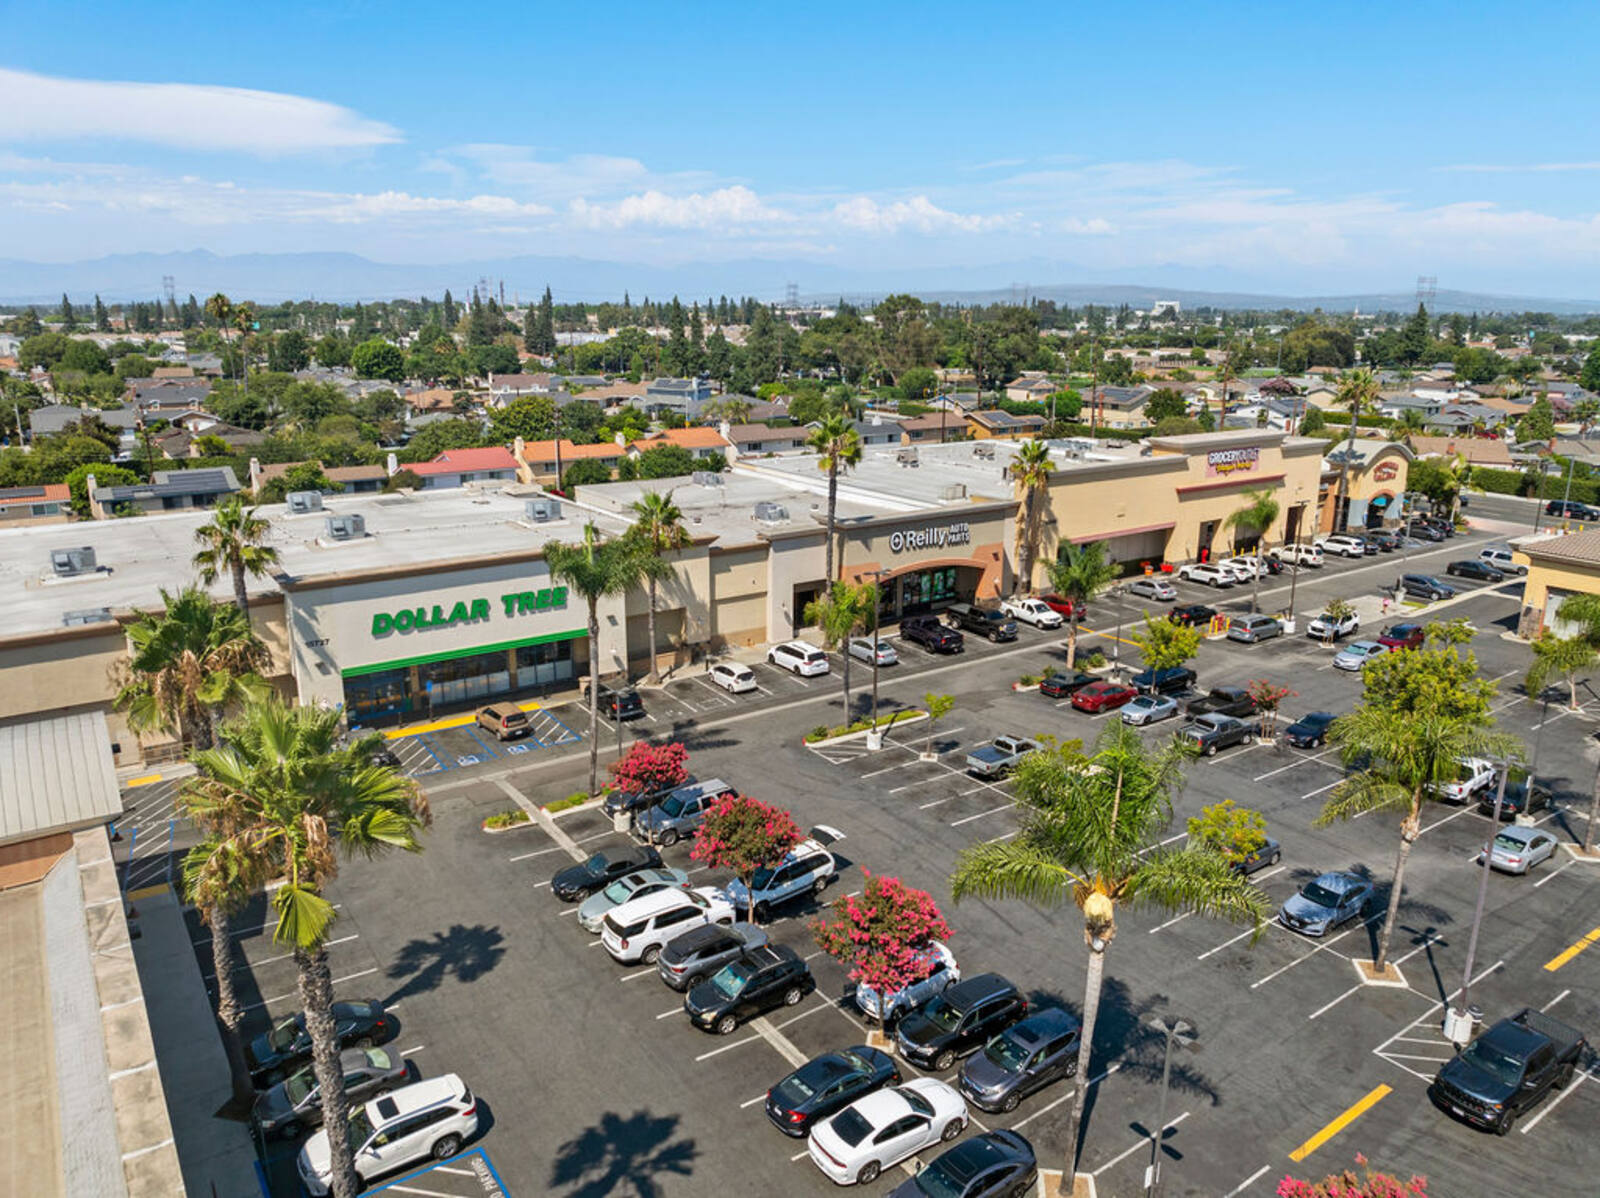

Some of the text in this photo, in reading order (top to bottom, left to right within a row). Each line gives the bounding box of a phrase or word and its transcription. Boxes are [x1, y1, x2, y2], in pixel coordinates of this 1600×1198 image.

[950, 522, 969, 534] AUTO
[890, 527, 946, 551] O'Reilly
[948, 532, 970, 545] PARTS
[371, 585, 569, 638] DOLLAR TREE
